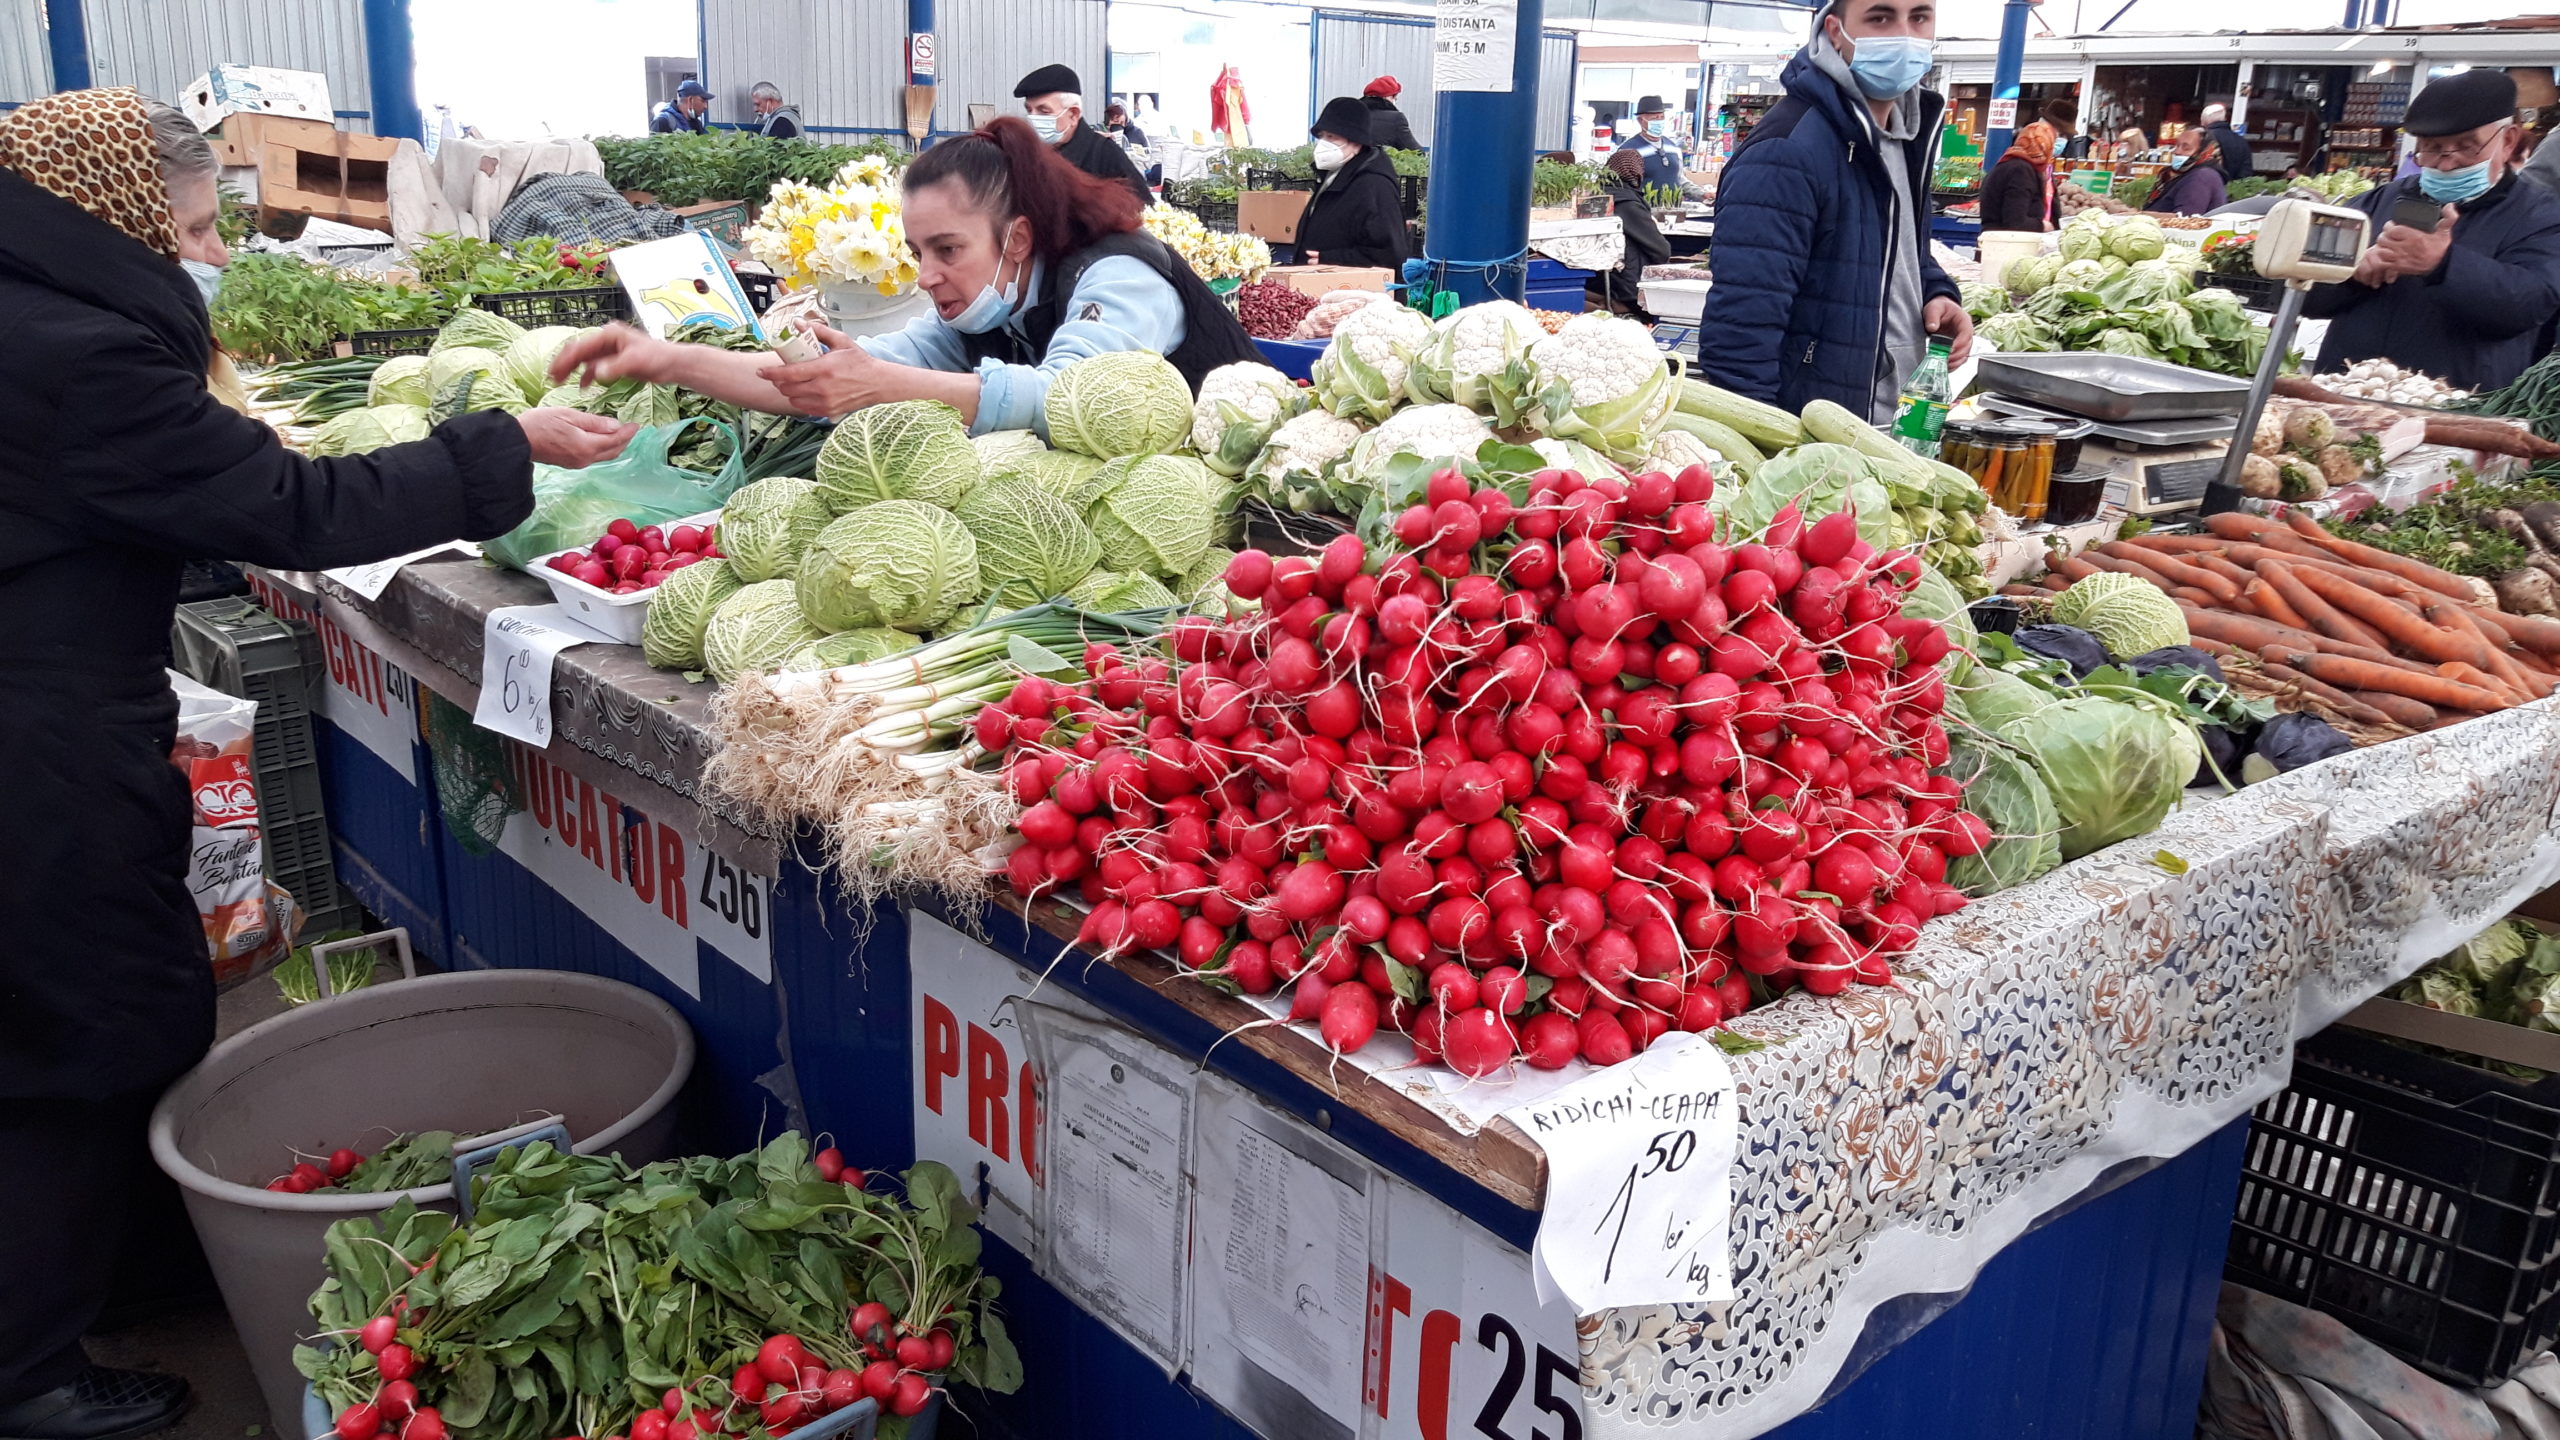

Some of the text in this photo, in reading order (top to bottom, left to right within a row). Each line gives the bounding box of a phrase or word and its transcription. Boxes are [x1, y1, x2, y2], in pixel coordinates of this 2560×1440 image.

[1443, 18, 1496, 30] DISTANTA
[1453, 41, 1470, 55] 1,5
[1474, 42, 1486, 54] M
[2072, 42, 2082, 50] 37
[2229, 38, 2241, 47] 38
[2404, 38, 2417, 47] 39
[503, 654, 520, 714] 6
[700, 845, 762, 940] 256
[1594, 1129, 1697, 1285] 1 50
[1473, 1312, 1583, 1440] 25
